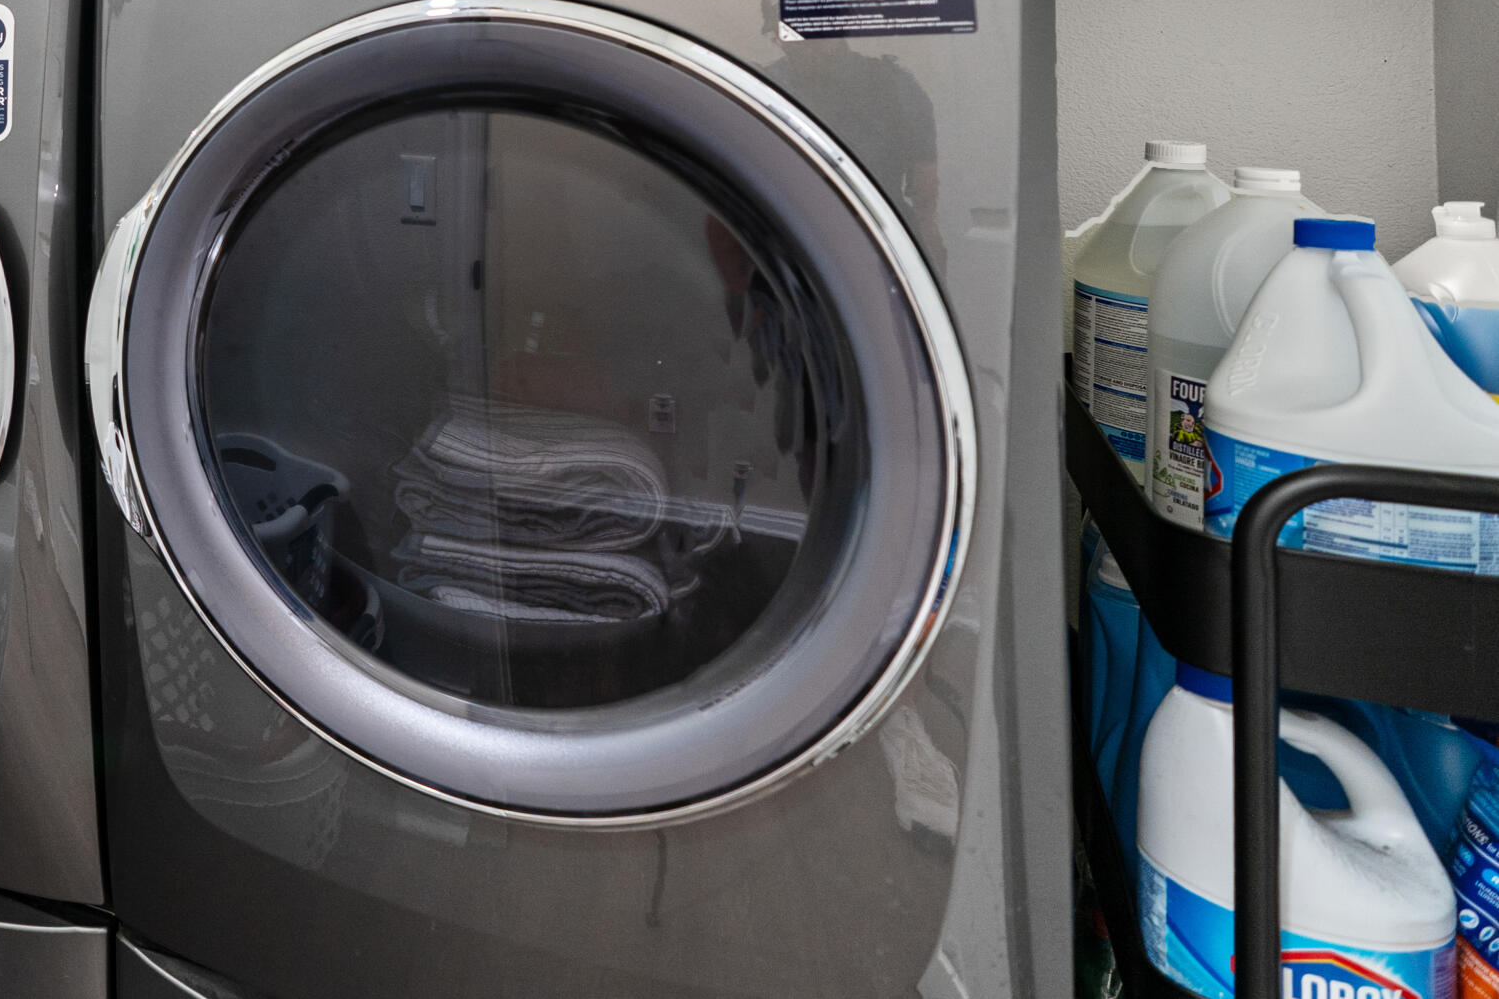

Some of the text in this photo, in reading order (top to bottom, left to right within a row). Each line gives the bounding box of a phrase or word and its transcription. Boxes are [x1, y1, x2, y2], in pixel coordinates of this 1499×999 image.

[1172, 441, 1205, 459] DISTILLED
[1170, 451, 1194, 468] VINAGRE
[1180, 481, 1199, 492] COCINA
